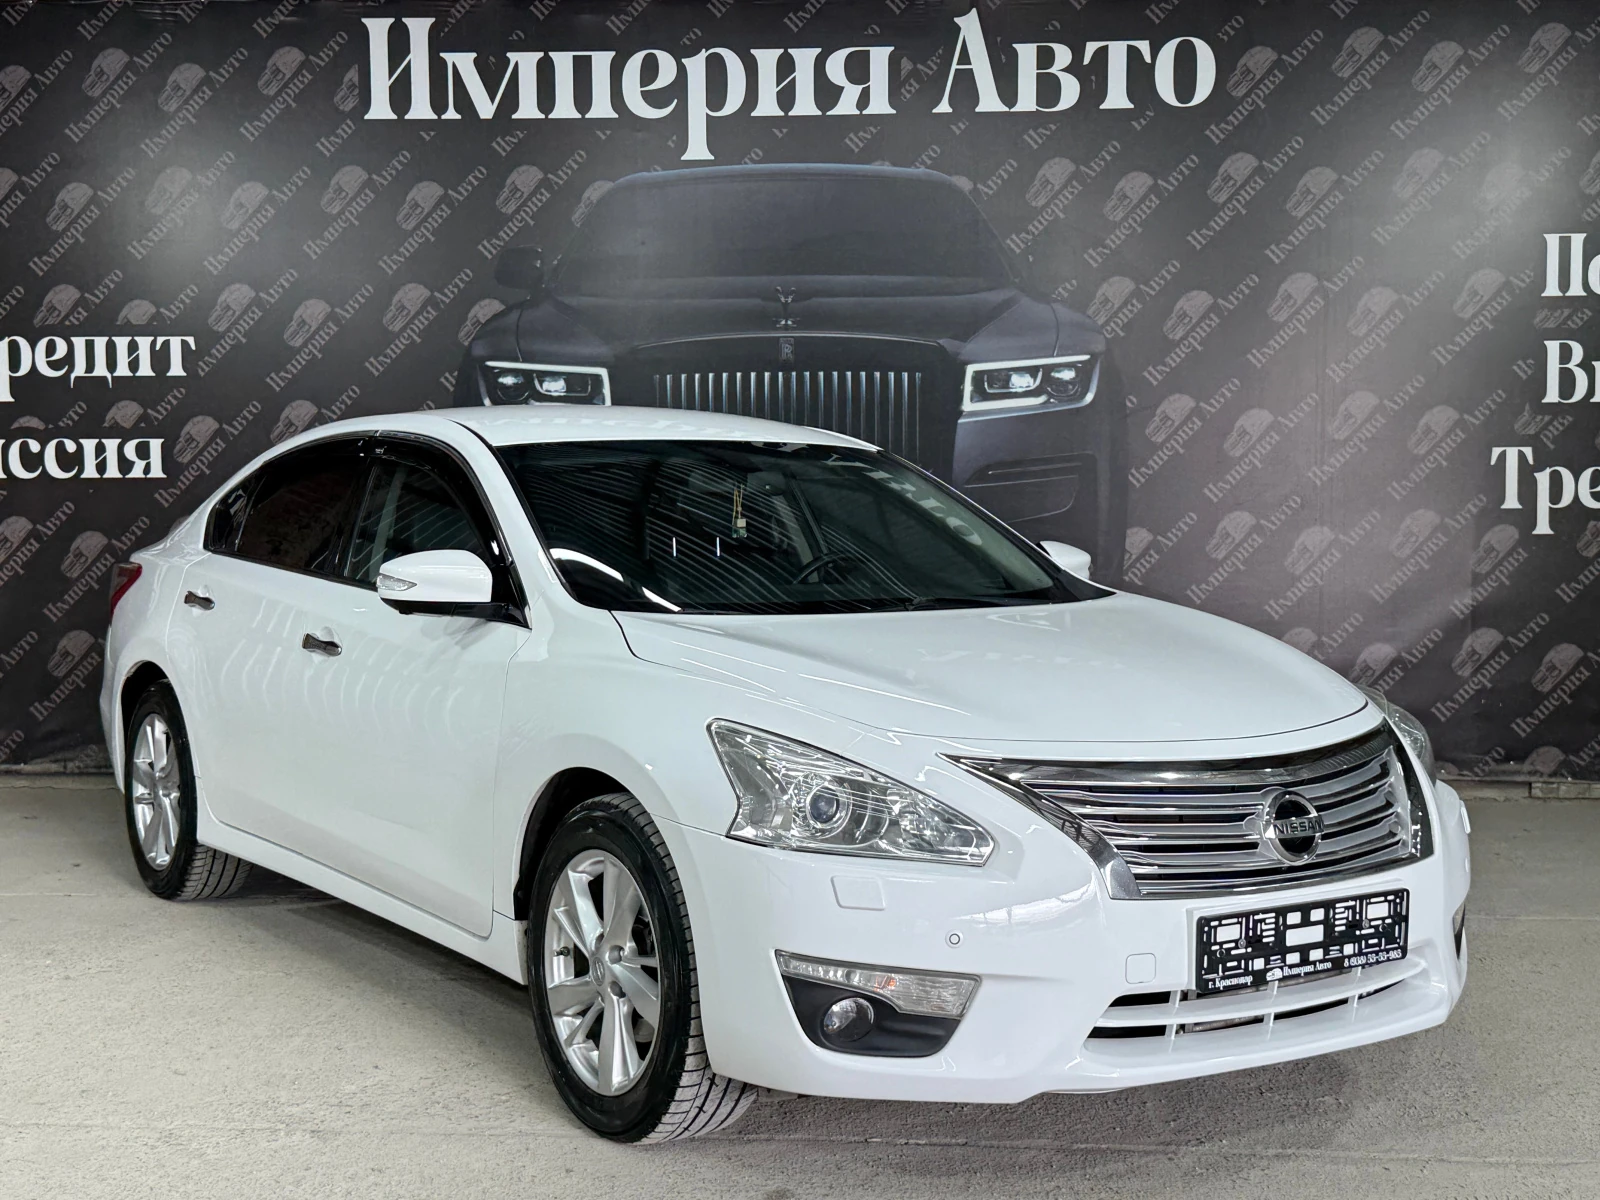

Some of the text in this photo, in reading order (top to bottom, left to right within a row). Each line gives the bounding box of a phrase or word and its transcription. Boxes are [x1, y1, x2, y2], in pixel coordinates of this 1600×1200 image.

[34, 49, 73, 91] Авто
[64, 32, 173, 144] Империя Авто
[140, 85, 213, 159] Империя
[207, 47, 249, 88] Авто
[239, 70, 313, 143] Империя
[306, 30, 349, 72] Авто
[361, 7, 1217, 161] Империя Авто
[1204, 69, 1284, 145] Империя
[1280, 29, 1324, 72] Авто
[1310, 10, 1431, 126] Империя Авто
[20, 152, 61, 193] Авто
[302, 187, 375, 260] Империя
[368, 149, 412, 193] Авто
[477, 187, 552, 260] Империя
[546, 149, 588, 190] Авто
[973, 158, 1019, 201] Авто
[1006, 140, 1121, 254] Империя Авто
[1186, 136, 1304, 251] Империя Авто
[28, 205, 101, 278] Империя
[96, 167, 137, 208] Авто
[377, 165, 488, 276] Империя Авто
[1084, 154, 1200, 268] Империя Авто
[80, 268, 123, 309] Авто
[157, 284, 199, 325] Авто
[257, 268, 299, 309] Авто
[1138, 259, 1181, 301] Авто
[265, 284, 375, 393] Империя Авто
[364, 268, 475, 378] Империя Авто
[1142, 273, 1260, 387] Империя Авто
[145, 387, 186, 427] Авто
[320, 384, 361, 424] Авто
[1541, 340, 1600, 403] В
[0, 437, 167, 479] ссия
[153, 400, 263, 508] Империя Авто
[1128, 377, 1242, 488] Империя Авто
[36, 500, 76, 541] Авто
[1155, 511, 1199, 552] Авто
[42, 515, 151, 623] Империя Авто
[1450, 547, 1530, 619] Империя
[3, 630, 39, 670] Авто
[1320, 612, 1365, 655] Авто
[1398, 628, 1443, 669] Авто
[1430, 648, 1511, 722] Империя
[1505, 612, 1550, 653] Авто
[29, 652, 102, 722] Империя
[1510, 664, 1592, 738] Империя
[1273, 819, 1324, 835] NISSAN
[1282, 964, 1314, 976] Империя
[1315, 961, 1332, 971] Авто
